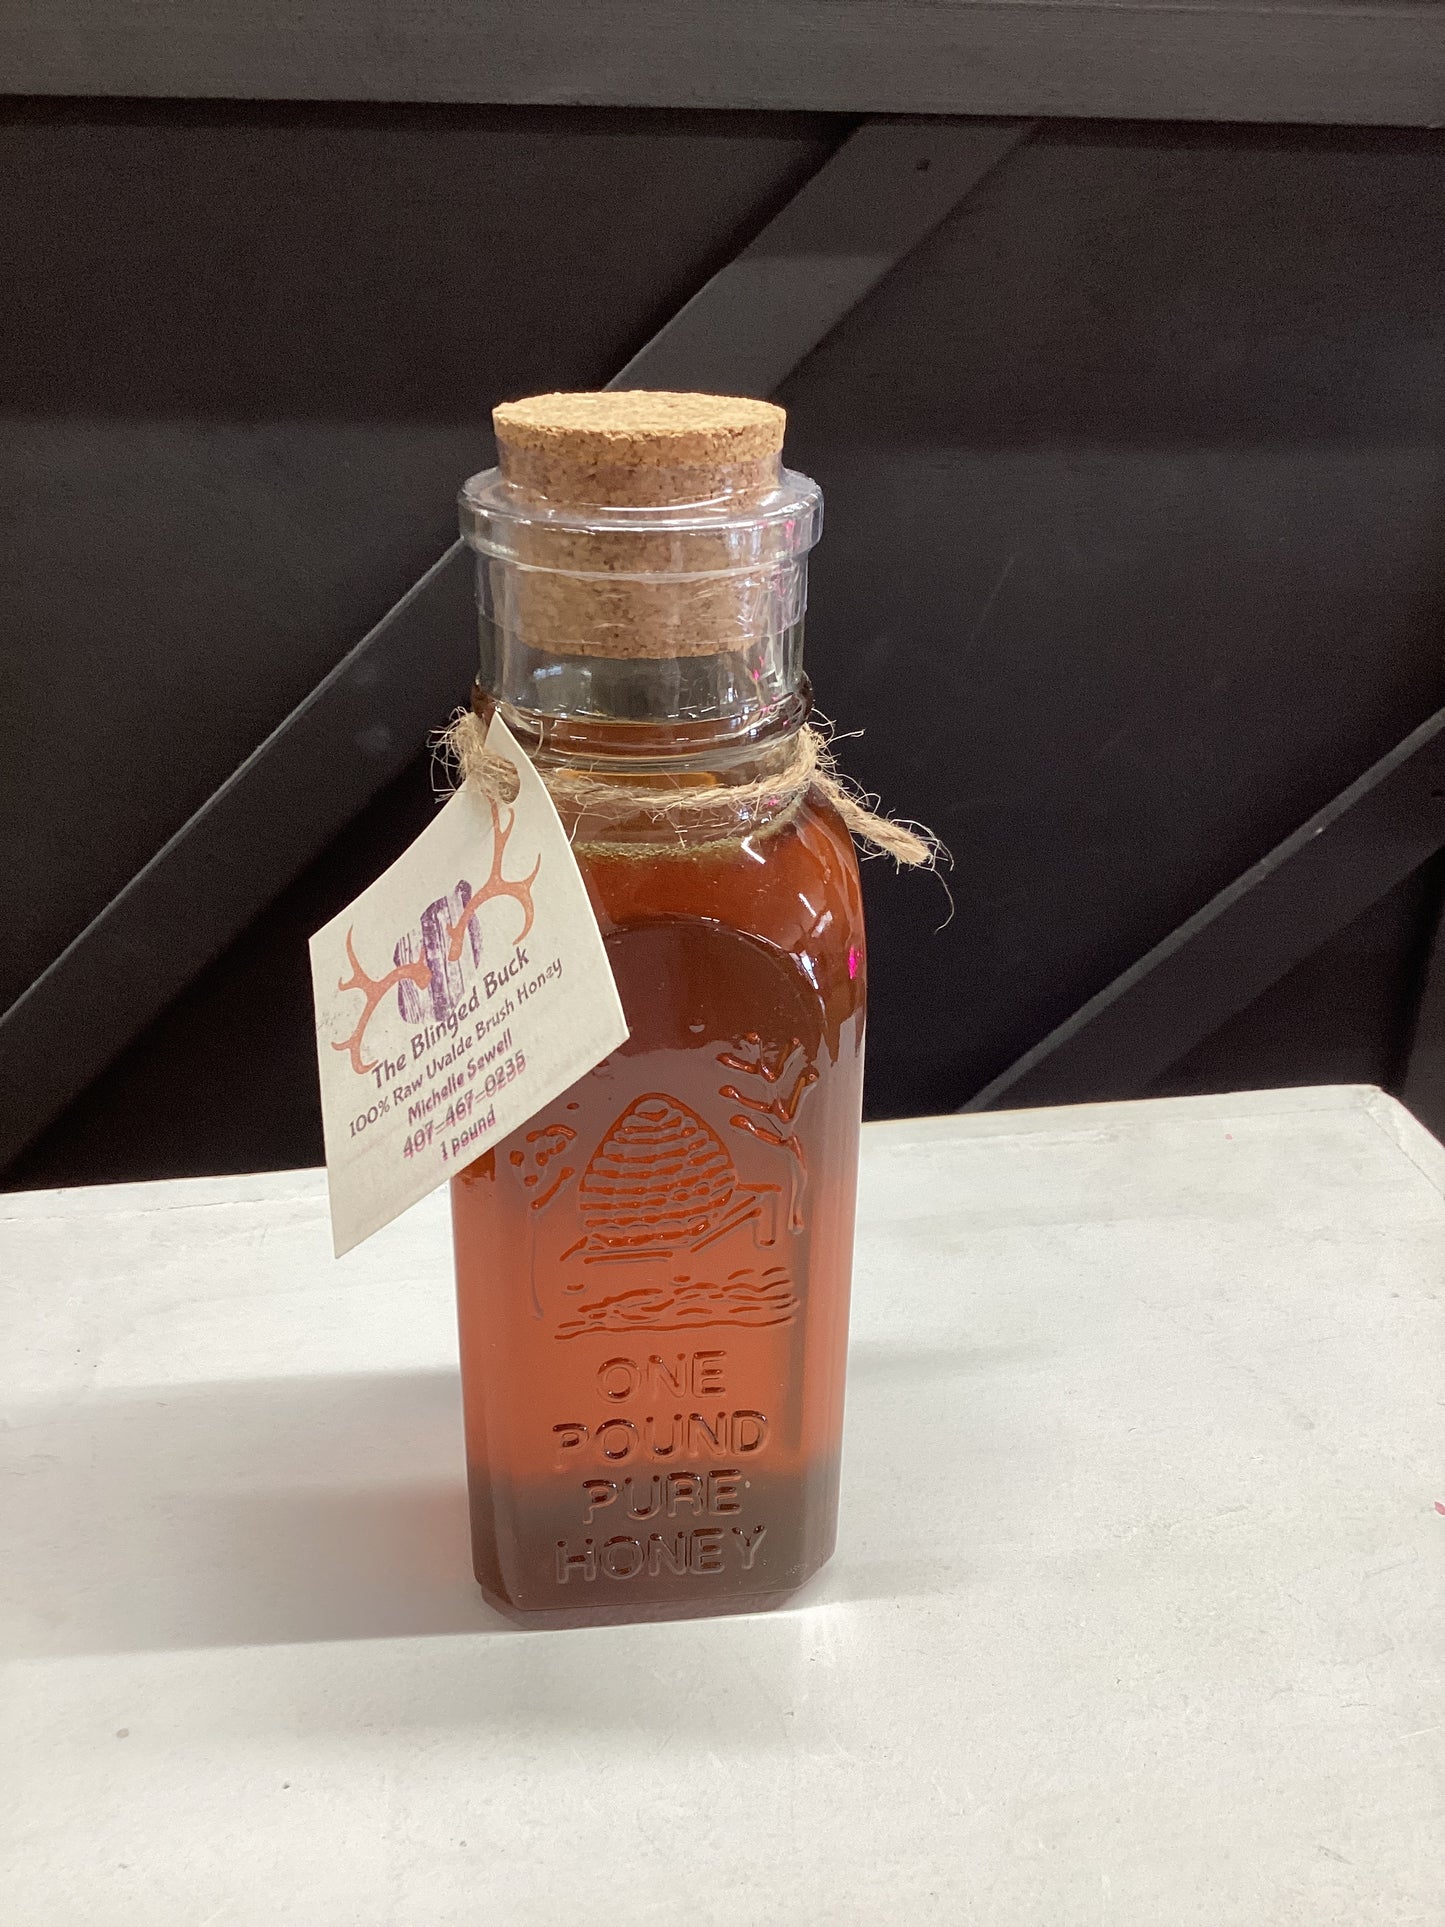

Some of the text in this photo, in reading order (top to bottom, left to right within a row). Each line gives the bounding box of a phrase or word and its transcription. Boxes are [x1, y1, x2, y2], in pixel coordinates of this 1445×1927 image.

[372, 946, 530, 1089] The Blinged Buck
[349, 957, 563, 1138] 100% Raw Uvalde Brush Honey
[407, 1069, 466, 1126] Michelle
[451, 1103, 496, 1157] pound
[597, 1350, 727, 1404] ONE
[552, 1409, 769, 1470] POUND
[582, 1468, 742, 1524] PURE
[555, 1524, 767, 1585] HONEY
